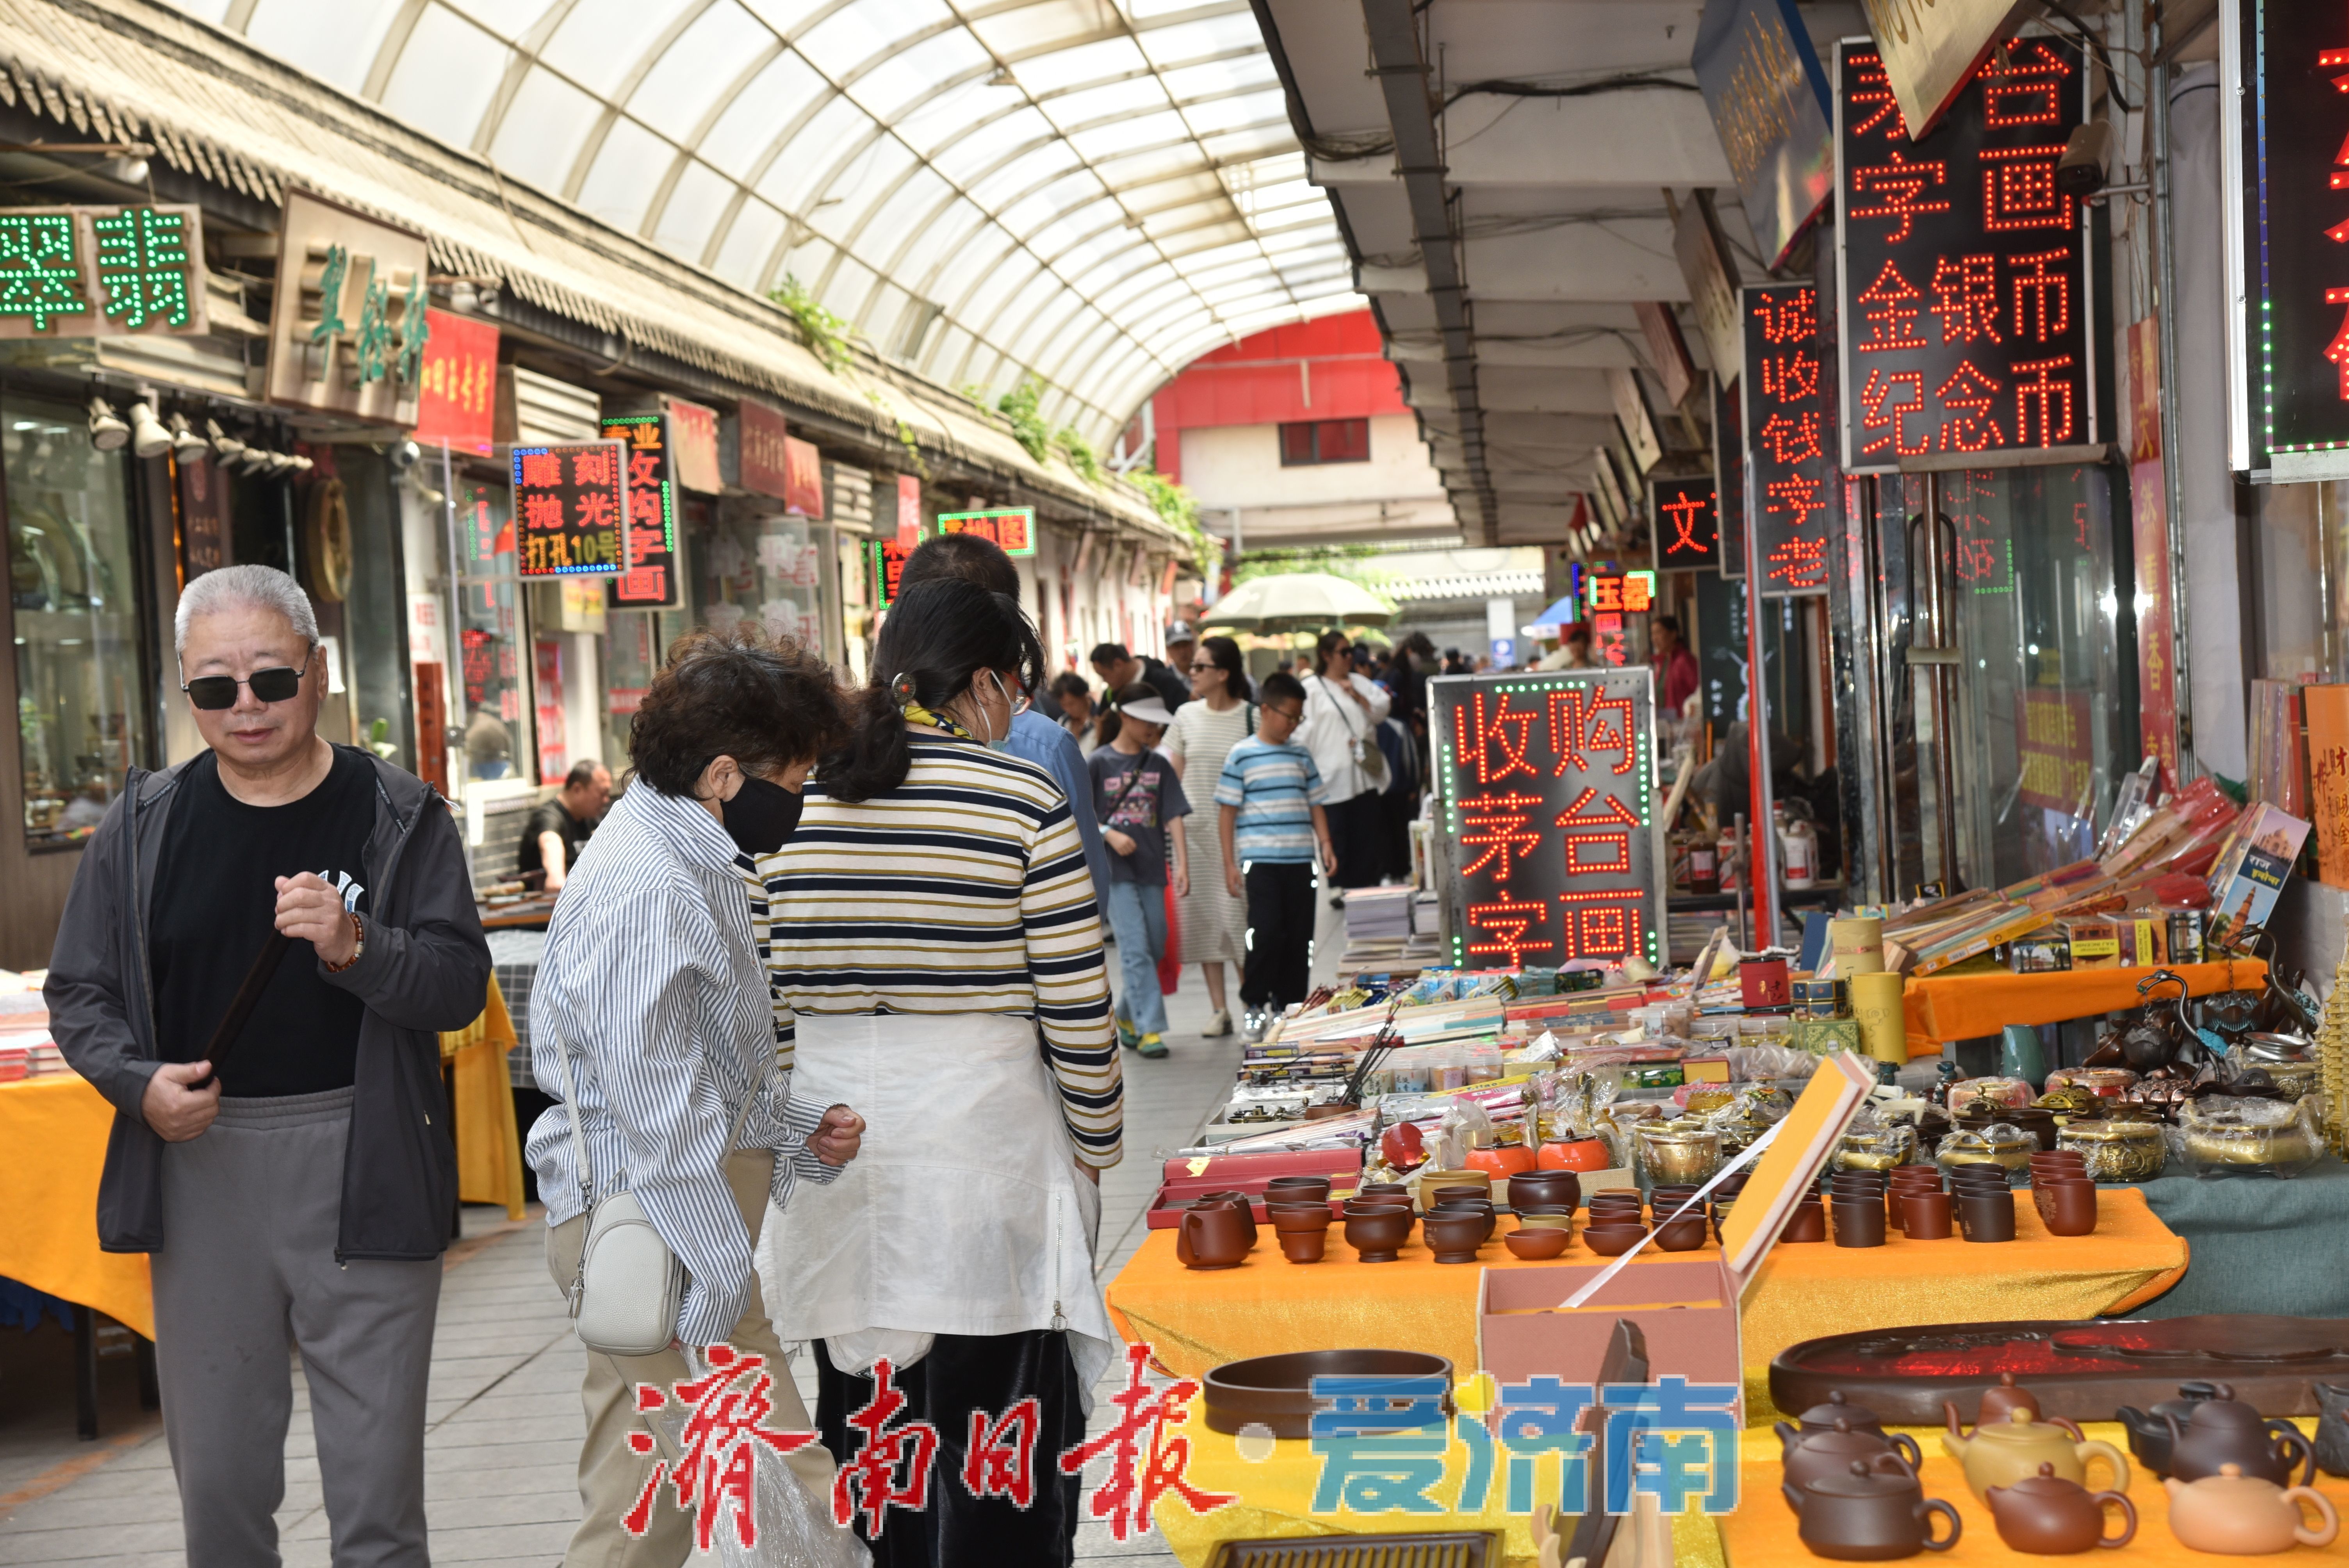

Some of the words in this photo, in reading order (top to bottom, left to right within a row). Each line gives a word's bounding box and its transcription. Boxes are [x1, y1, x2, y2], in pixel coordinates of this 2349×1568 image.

[1850, 146, 2076, 244] 字画
[1858, 246, 2072, 353] 金银币
[1861, 353, 2075, 456] 纪念币
[522, 451, 611, 487] 雕刻
[524, 492, 614, 529] 抛光
[526, 531, 617, 569] 打孔10号
[1593, 575, 1651, 612] 玉器
[1453, 685, 1635, 784] 收购
[1457, 786, 1641, 883] 茅台
[1467, 888, 1644, 969] 字画
